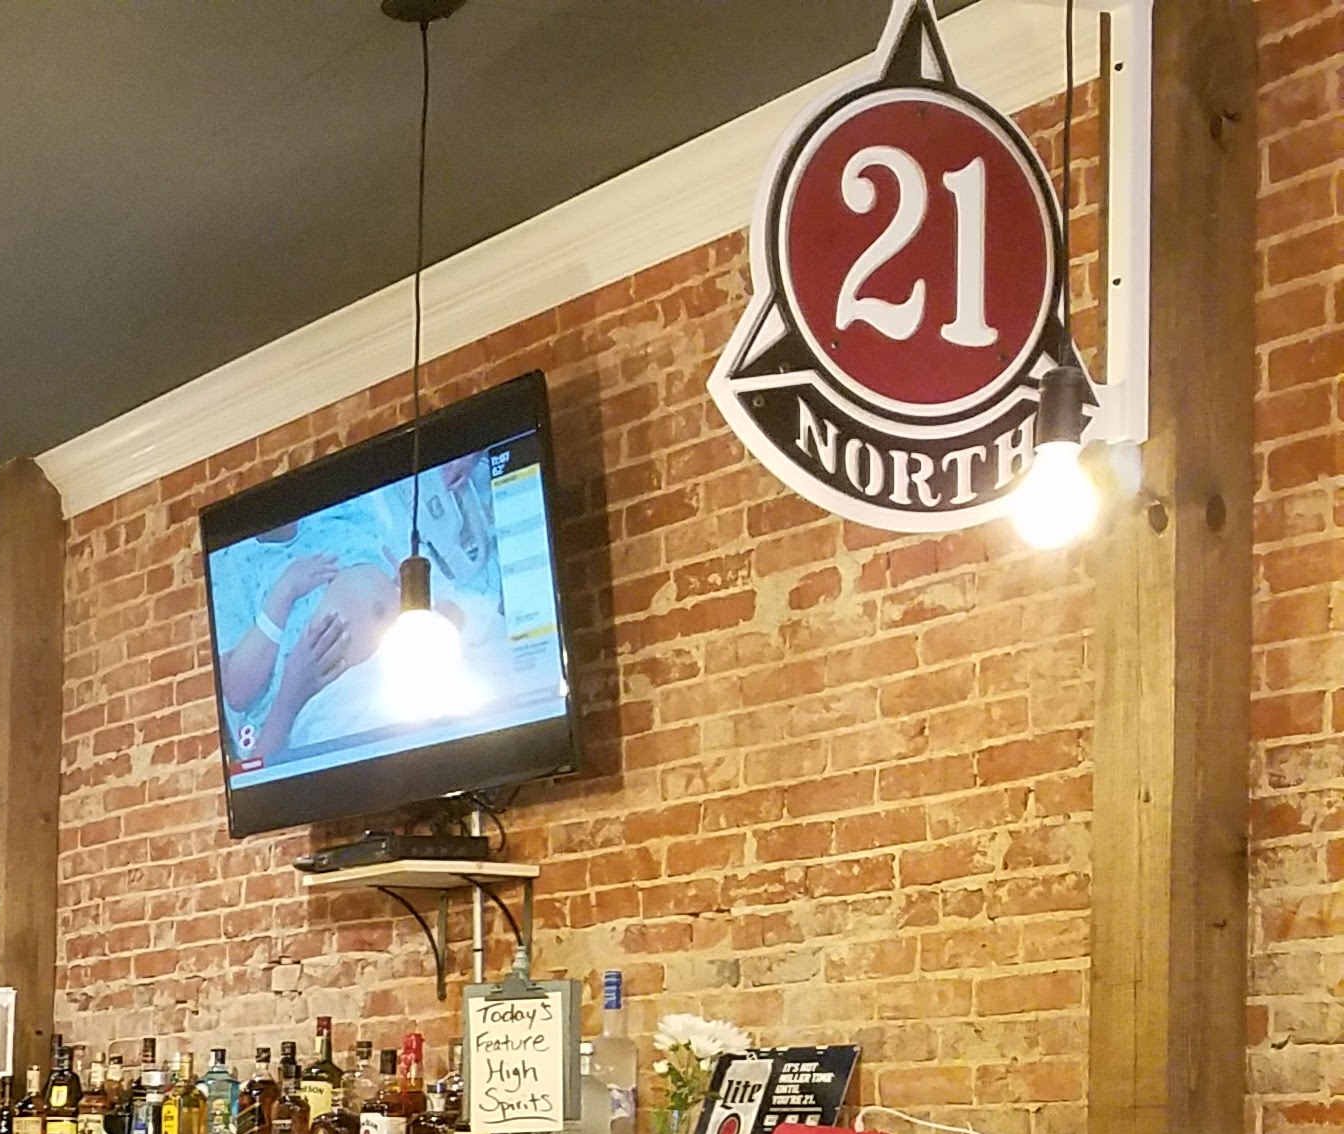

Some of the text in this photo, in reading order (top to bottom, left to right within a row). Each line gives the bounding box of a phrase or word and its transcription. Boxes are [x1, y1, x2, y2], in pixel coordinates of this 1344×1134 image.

[835, 144, 998, 348] 21
[795, 396, 1038, 507] NORTH
[476, 1002, 553, 1030] Today's
[476, 1031, 550, 1053] Feature
[486, 1058, 538, 1093] High
[479, 1087, 553, 1119] Spirits
